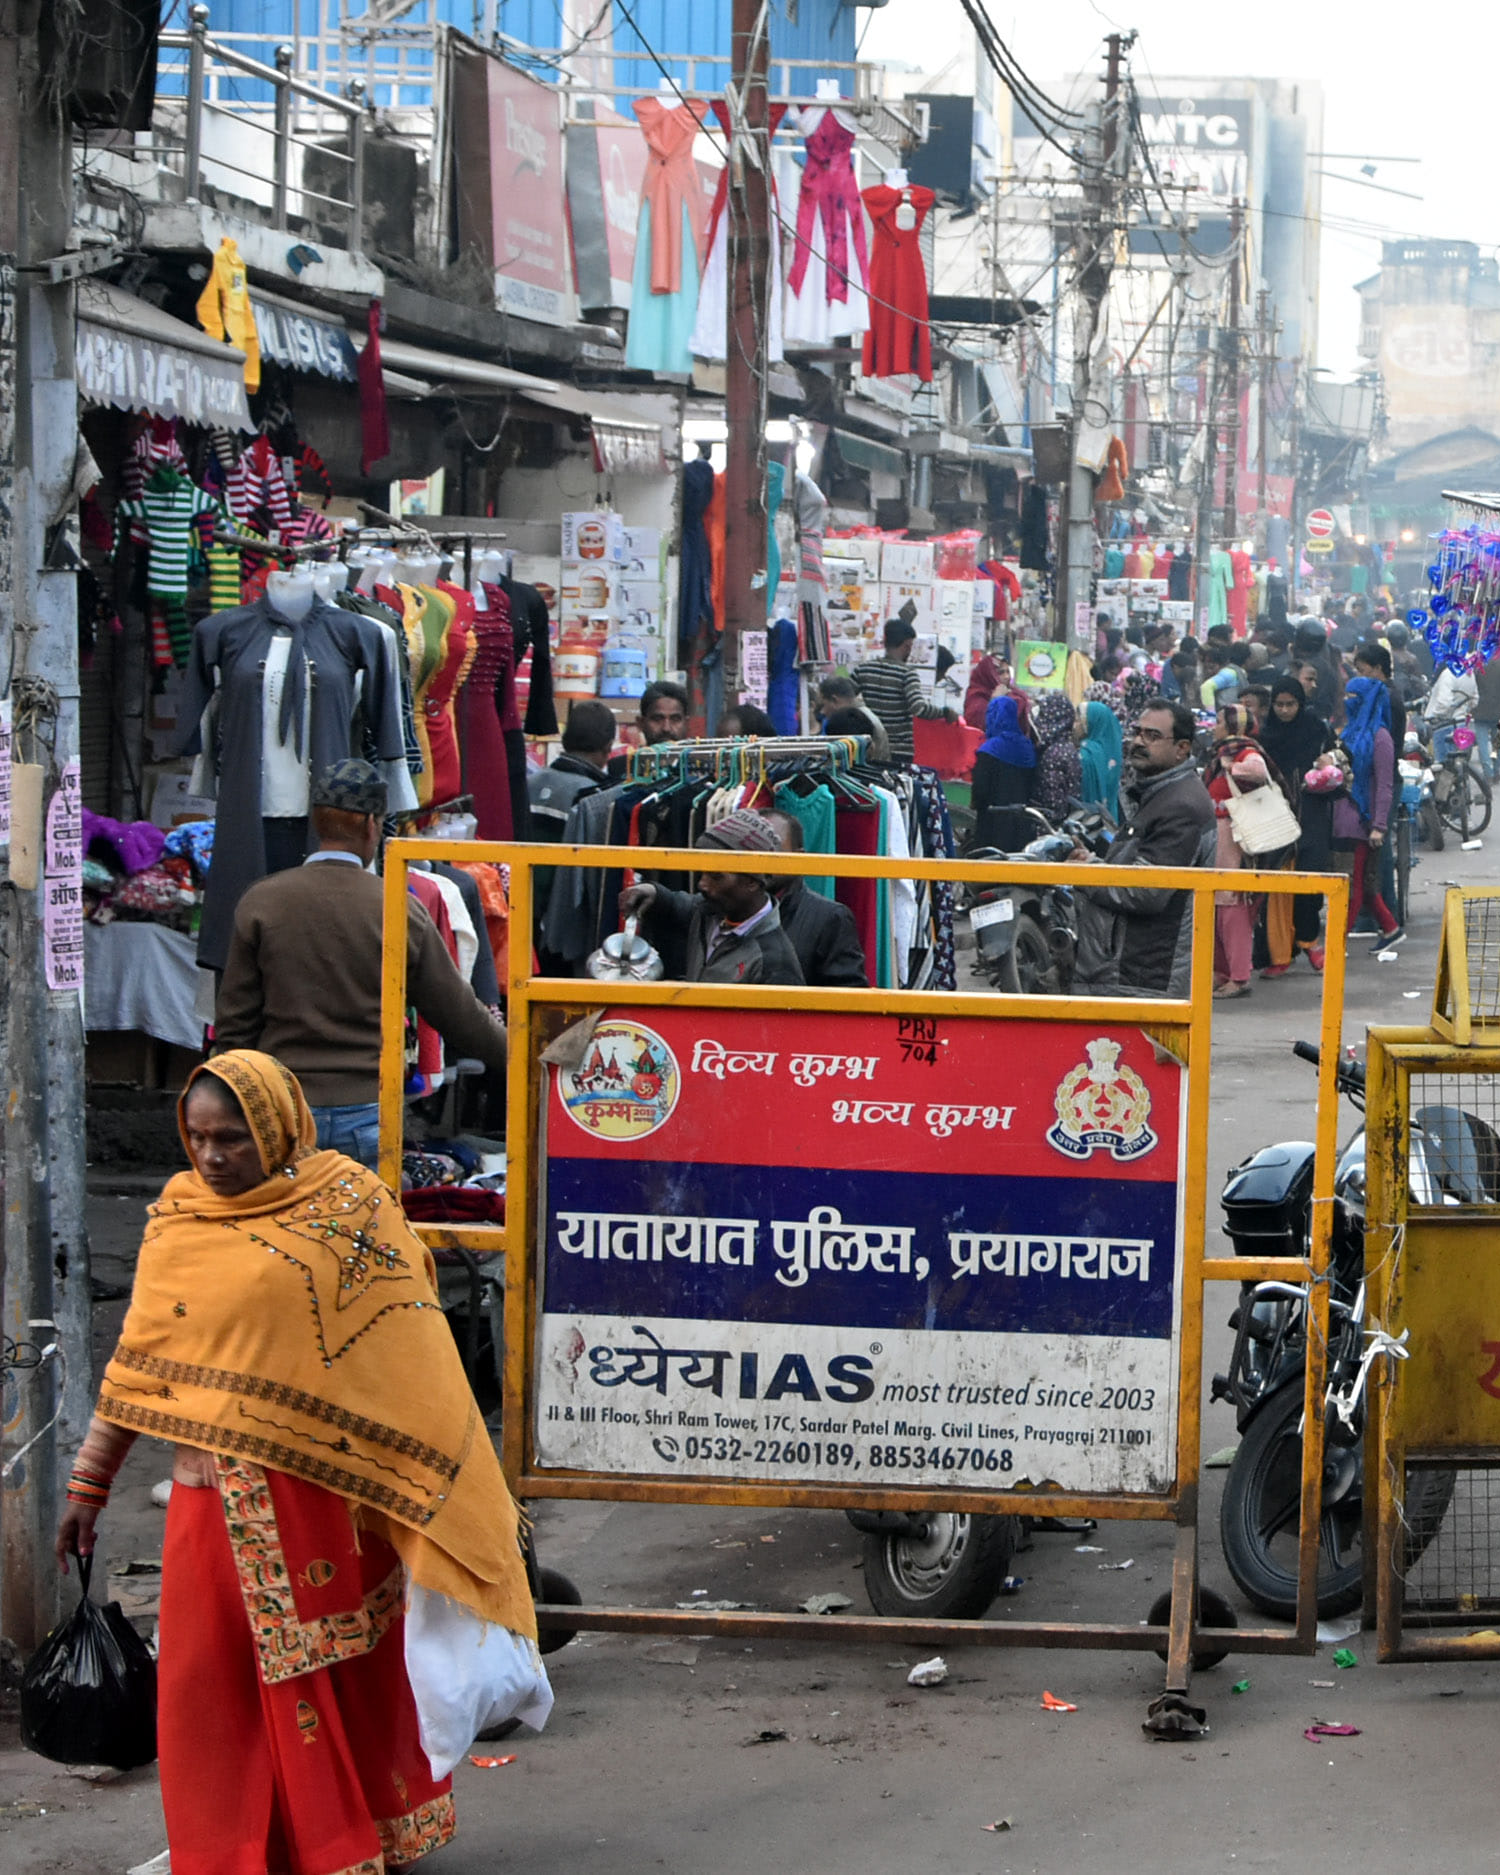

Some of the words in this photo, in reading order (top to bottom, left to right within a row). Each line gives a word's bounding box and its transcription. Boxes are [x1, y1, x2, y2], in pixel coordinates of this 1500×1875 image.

[1139, 114, 1240, 146] MTC
[54, 852, 76, 869] Mob.
[50, 883, 78, 905] ऑफ
[54, 965, 79, 982] Mob.
[898, 1018, 937, 1040] PRJ
[690, 1039, 779, 1080] दिव्य
[789, 1052, 880, 1087] कुम्भ
[900, 1042, 938, 1067] 704
[584, 1101, 632, 1128] कुम्भ
[831, 1098, 916, 1126] भव्य
[924, 1103, 1017, 1137] कुम्भ
[1085, 1131, 1118, 1146] प्रदेश
[1121, 1132, 1151, 1155] पुलिस
[556, 1212, 760, 1266] यातायात
[770, 1205, 930, 1288] पुलिस,
[947, 1232, 1155, 1282] प्रयागराज
[588, 1325, 733, 1398] ध्येय
[739, 1351, 875, 1402] IAS
[882, 1383, 941, 1405] most
[947, 1382, 1031, 1406] trusted
[1035, 1384, 1094, 1408] since
[1099, 1387, 1156, 1411] 2003
[564, 1407, 574, 1421] &
[580, 1407, 596, 1422] III
[601, 1407, 640, 1426] Floor,
[645, 1409, 673, 1426] Shri
[678, 1411, 709, 1428] Ram
[714, 1412, 759, 1432] Tower,
[763, 1414, 796, 1434] 17C,
[799, 1416, 848, 1434] Sardar
[852, 1419, 889, 1436] Patel
[893, 1421, 937, 1442] Marg.
[941, 1422, 973, 1439] Civil
[978, 1423, 1019, 1443] Lines,
[1024, 1425, 1095, 1447] Prayagraj
[1099, 1428, 1152, 1446] 211001
[684, 1436, 862, 1470] 0532-2260189,
[868, 1445, 1013, 1472] 8853467068
